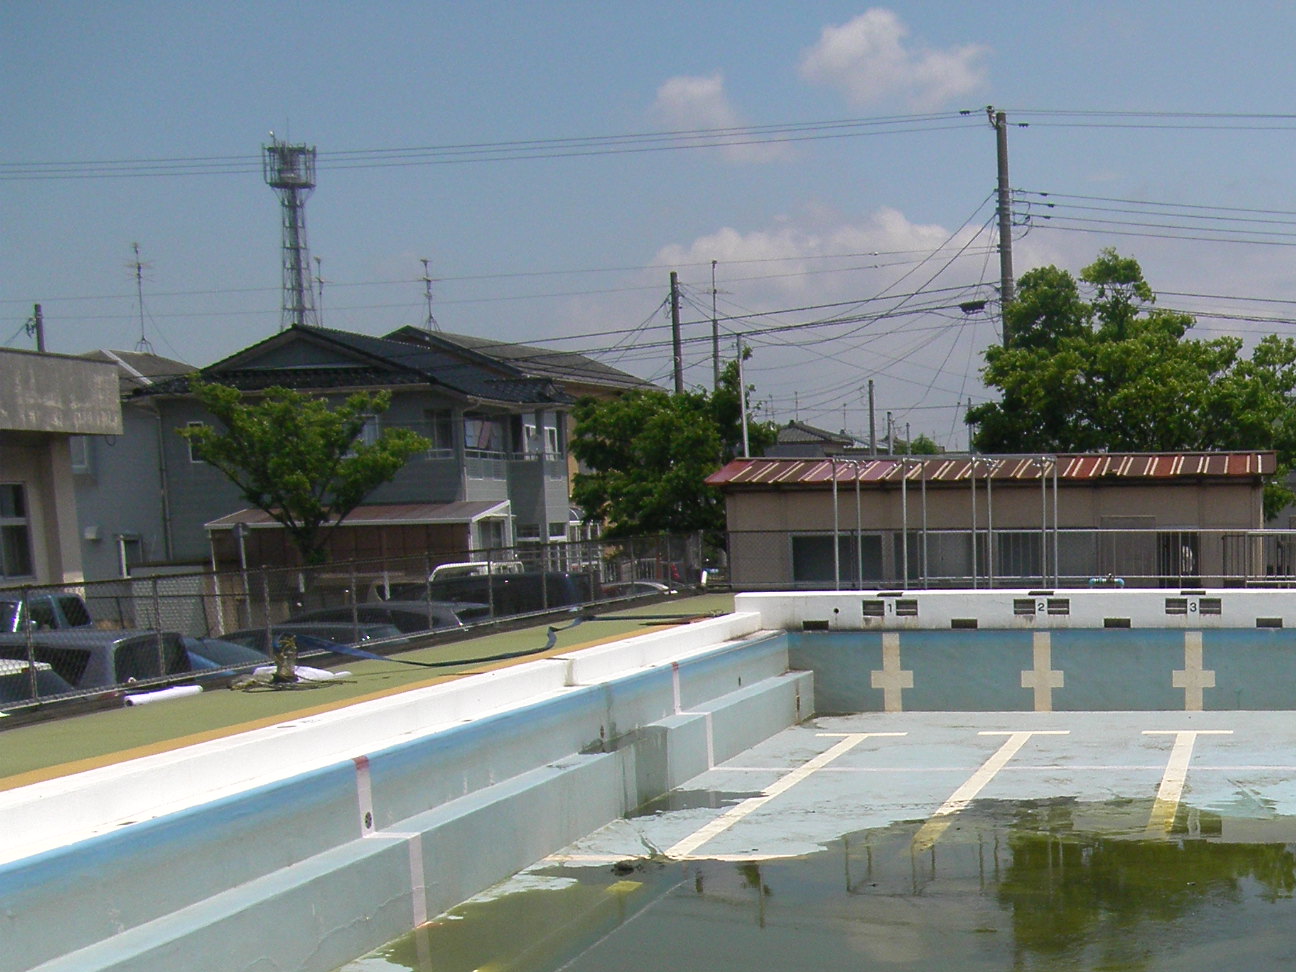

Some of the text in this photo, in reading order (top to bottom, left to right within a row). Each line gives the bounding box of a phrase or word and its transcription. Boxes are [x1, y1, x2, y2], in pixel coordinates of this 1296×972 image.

[887, 603, 893, 613] 1
[1037, 602, 1045, 611] 2
[1189, 602, 1198, 612] 3
